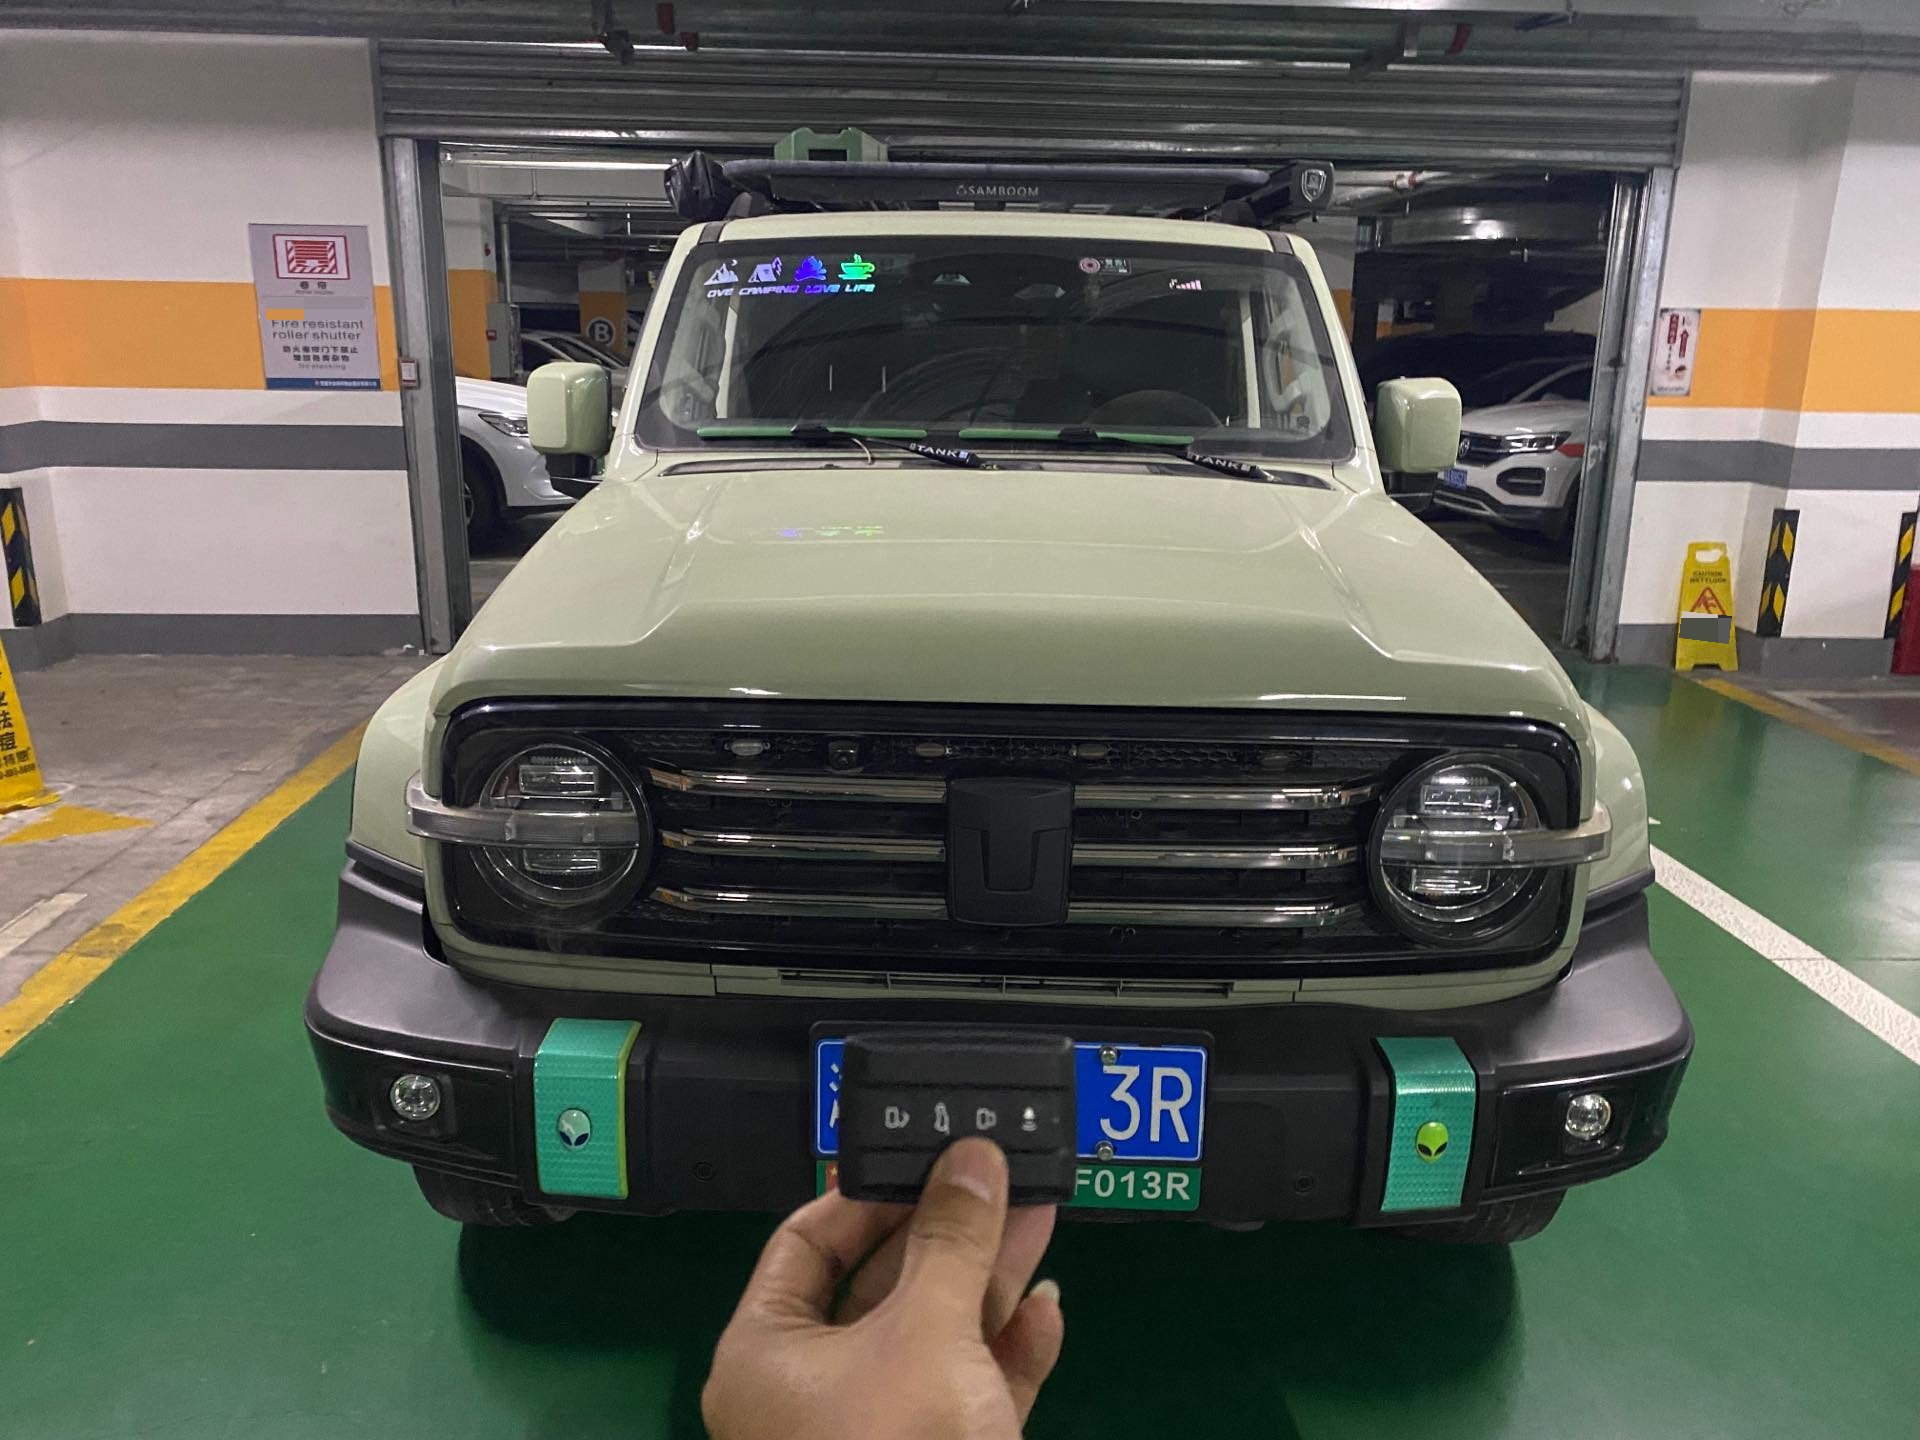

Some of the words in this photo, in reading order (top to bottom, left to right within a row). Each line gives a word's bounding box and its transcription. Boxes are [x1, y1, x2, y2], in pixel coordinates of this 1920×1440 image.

[845, 283, 876, 293] LIFE
[303, 319, 364, 330] resistant
[272, 331, 308, 340] roller
[312, 331, 361, 340] shutter
[594, 323, 610, 342] B
[917, 444, 958, 458] TANK
[1193, 453, 1239, 470] TANK
